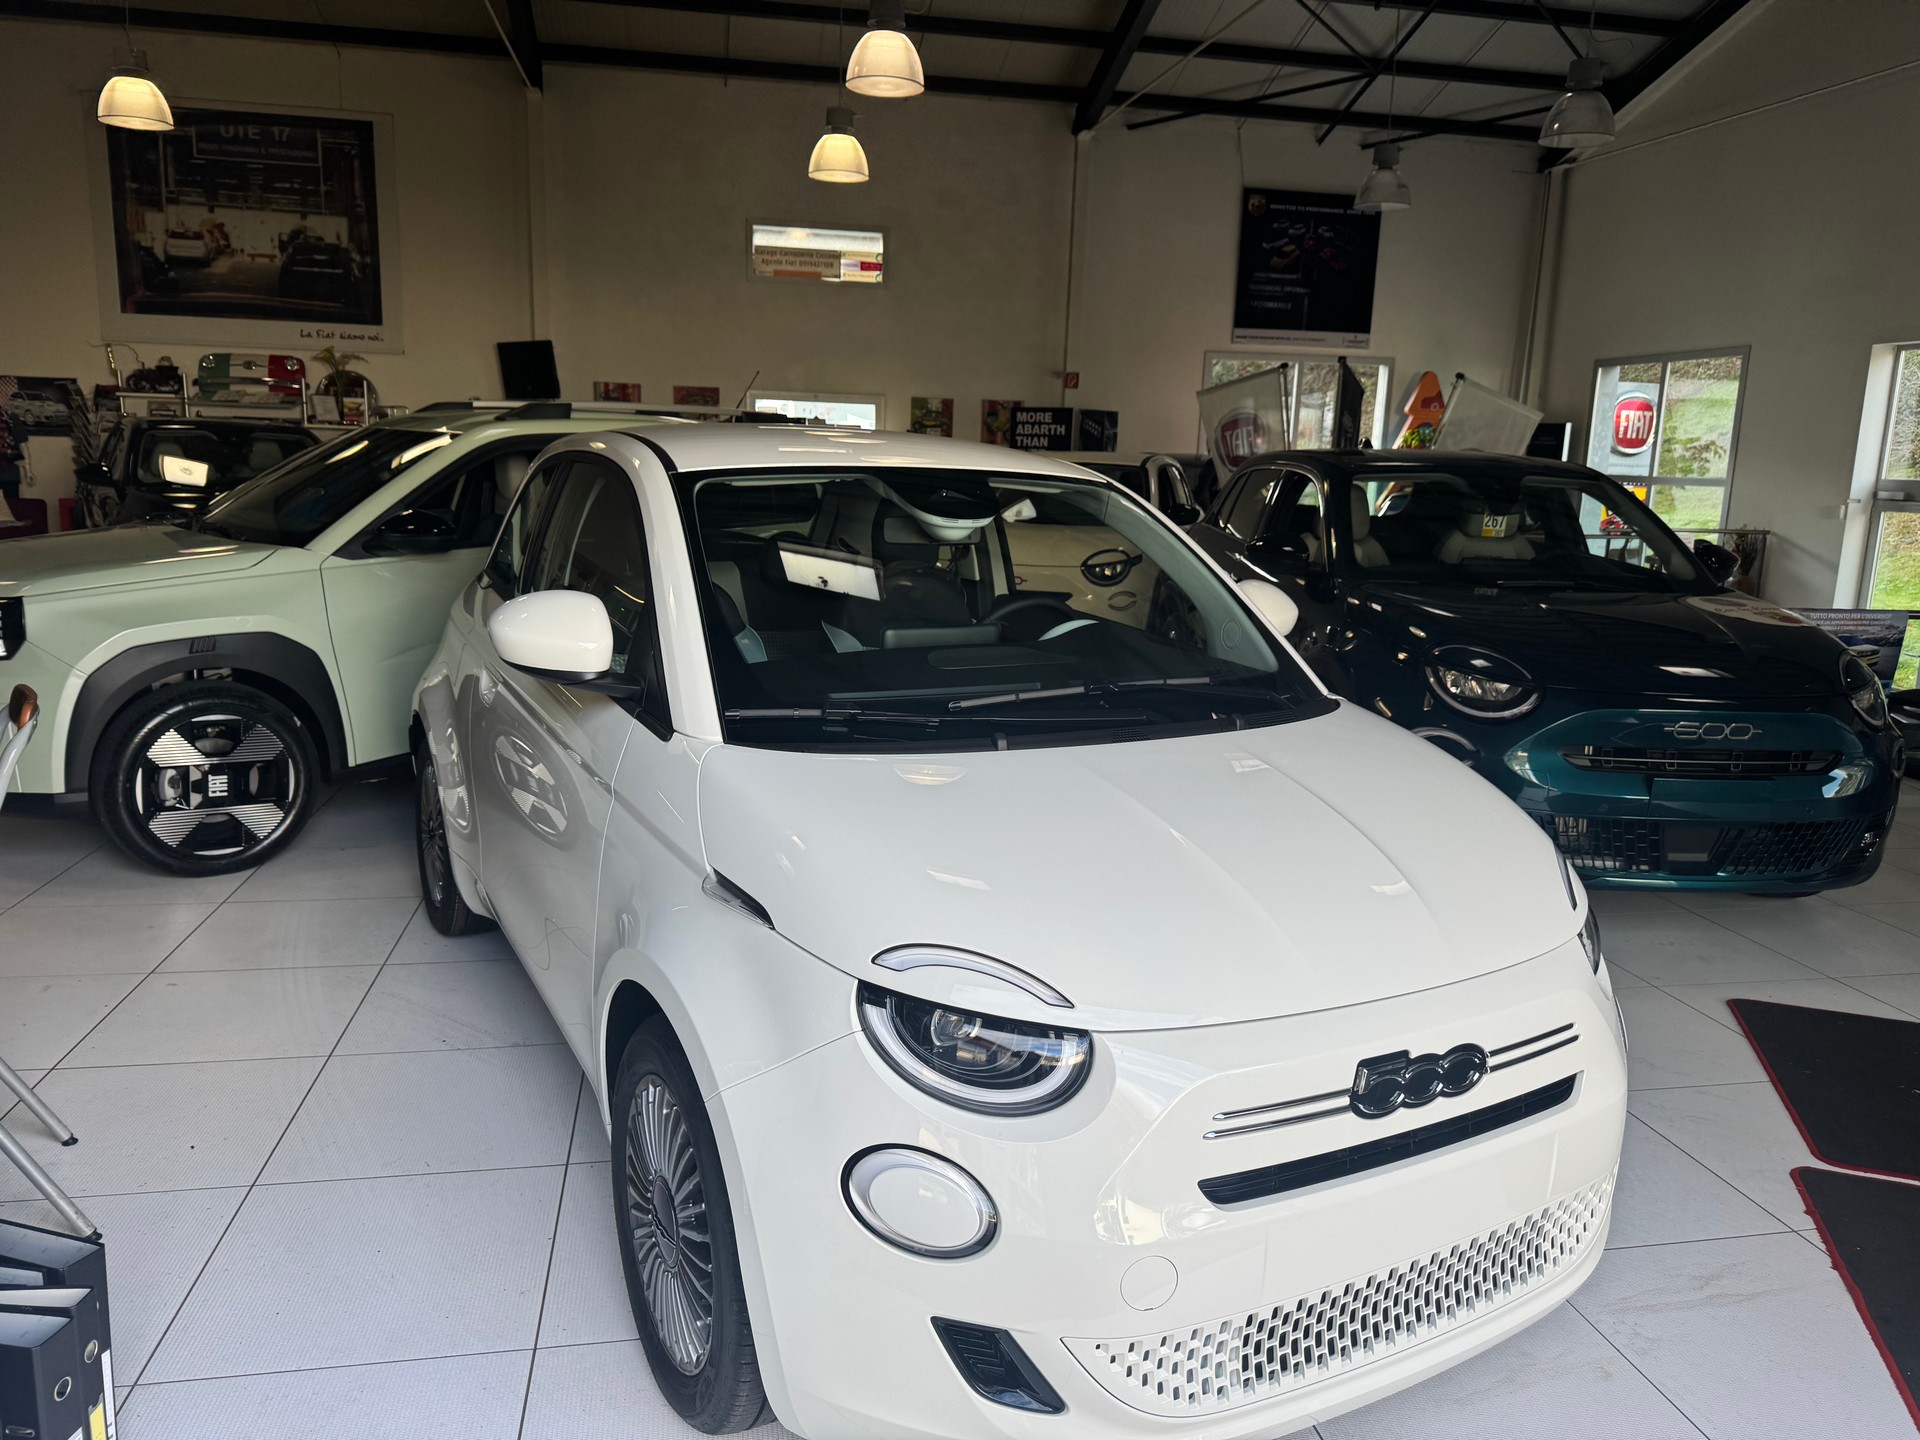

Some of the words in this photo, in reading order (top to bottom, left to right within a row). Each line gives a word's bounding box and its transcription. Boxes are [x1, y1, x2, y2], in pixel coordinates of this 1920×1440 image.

[300, 329, 313, 338] La
[316, 329, 336, 340] Fiat
[339, 331, 365, 341] siamo
[1016, 411, 1053, 423] MORE
[1618, 409, 1653, 440] FIAT
[1015, 424, 1066, 436] ABARTH
[1015, 436, 1049, 448] THAN
[1484, 513, 1506, 529] 267
[1672, 721, 1755, 740] 600
[208, 774, 229, 798] FIAT
[1350, 1043, 1487, 1119] 500
